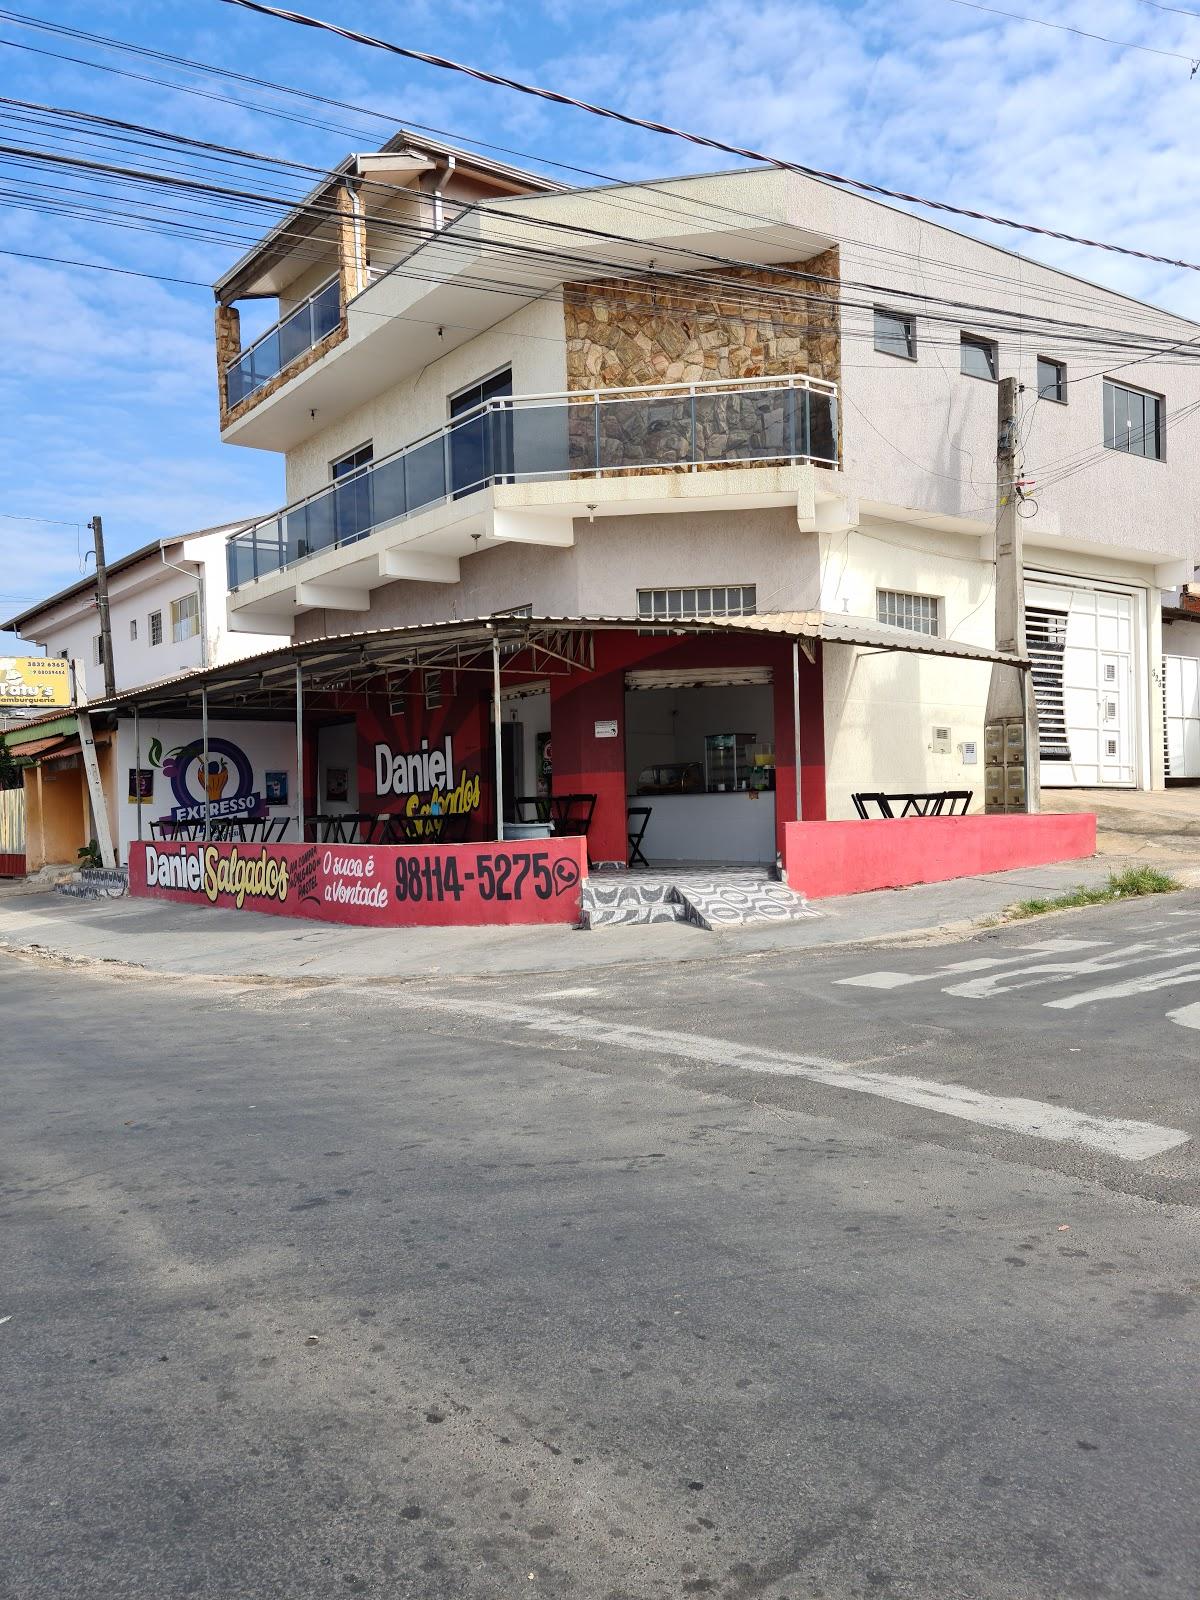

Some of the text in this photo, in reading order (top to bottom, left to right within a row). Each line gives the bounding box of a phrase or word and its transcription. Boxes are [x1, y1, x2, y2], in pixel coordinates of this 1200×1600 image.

[375, 735, 454, 796] Daniel
[145, 845, 289, 909] Daniel Salgados
[323, 851, 332, 875] O
[365, 855, 375, 878] é
[395, 852, 553, 902] 98114-5275
